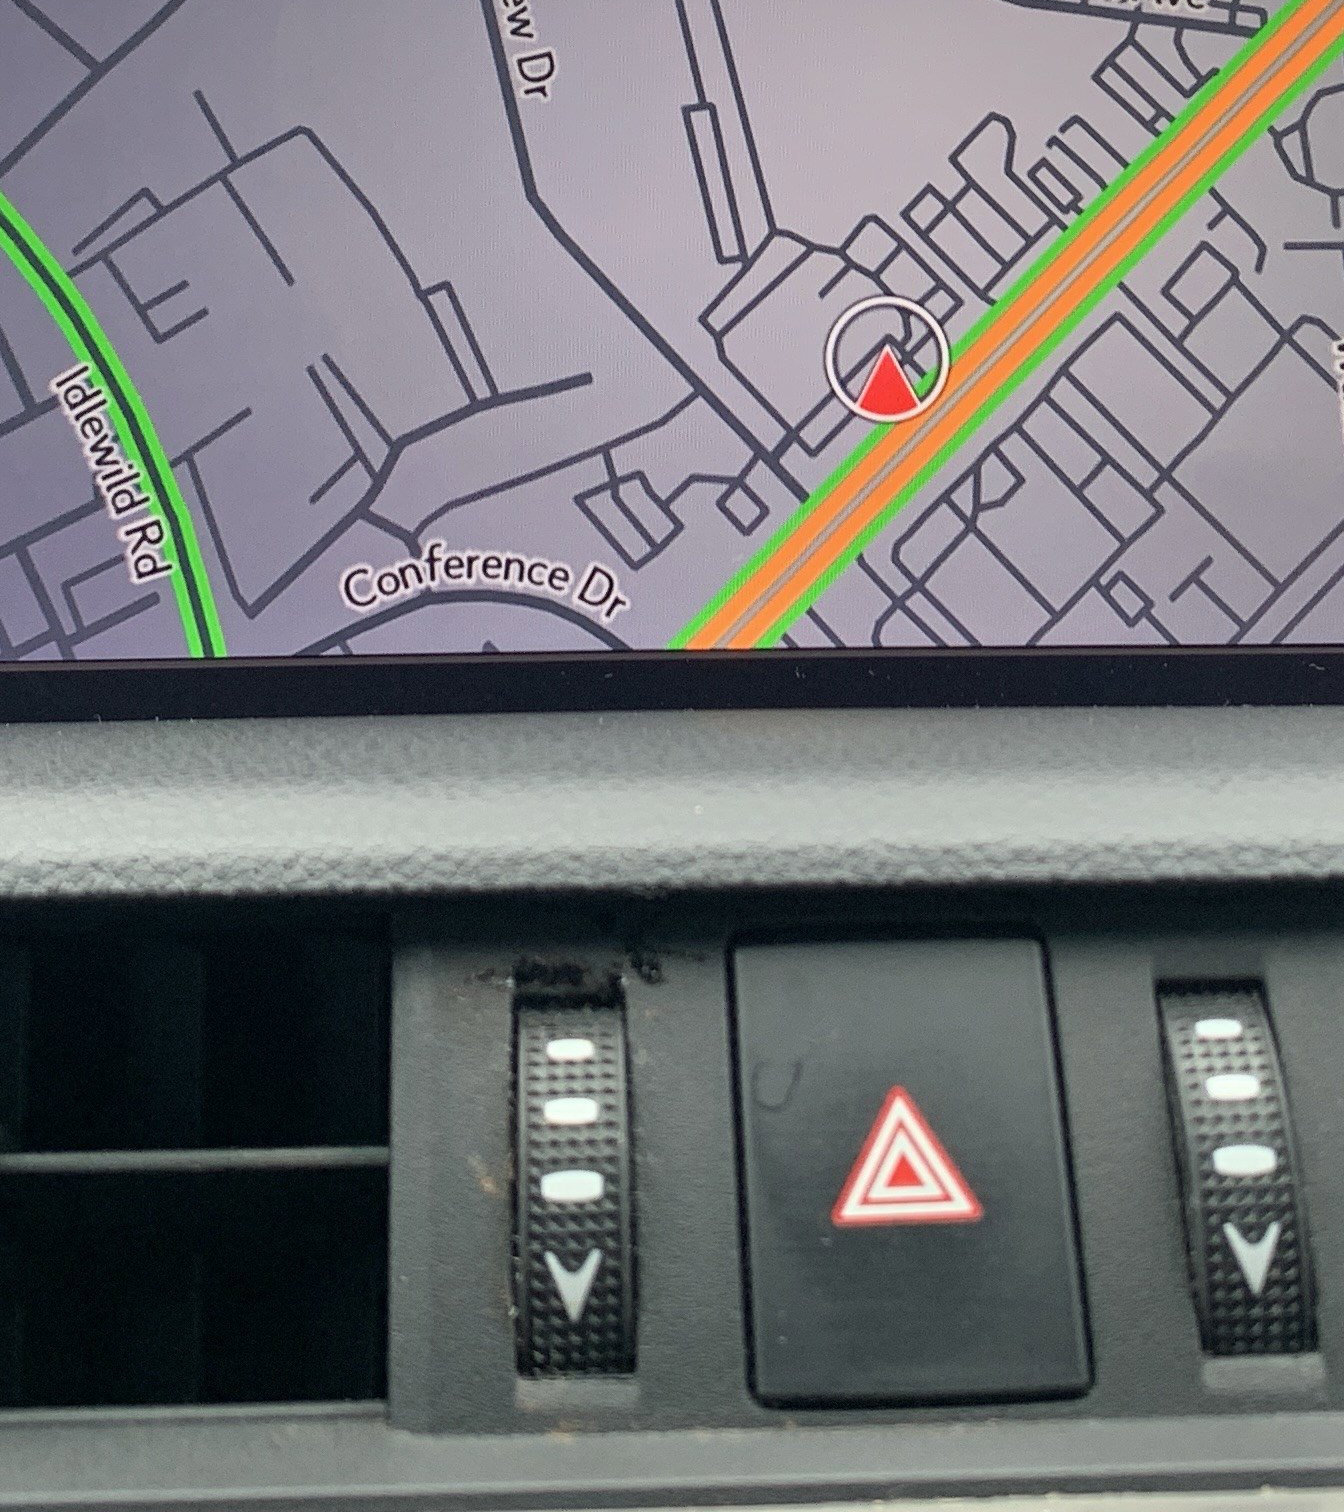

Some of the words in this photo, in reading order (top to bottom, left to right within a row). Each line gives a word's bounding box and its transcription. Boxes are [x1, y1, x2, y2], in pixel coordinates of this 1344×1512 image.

[516, 50, 556, 98] Dr
[55, 365, 151, 515] Idlewild
[124, 519, 173, 580] Rd
[343, 542, 570, 607] Conference
[577, 565, 627, 619] Dr
